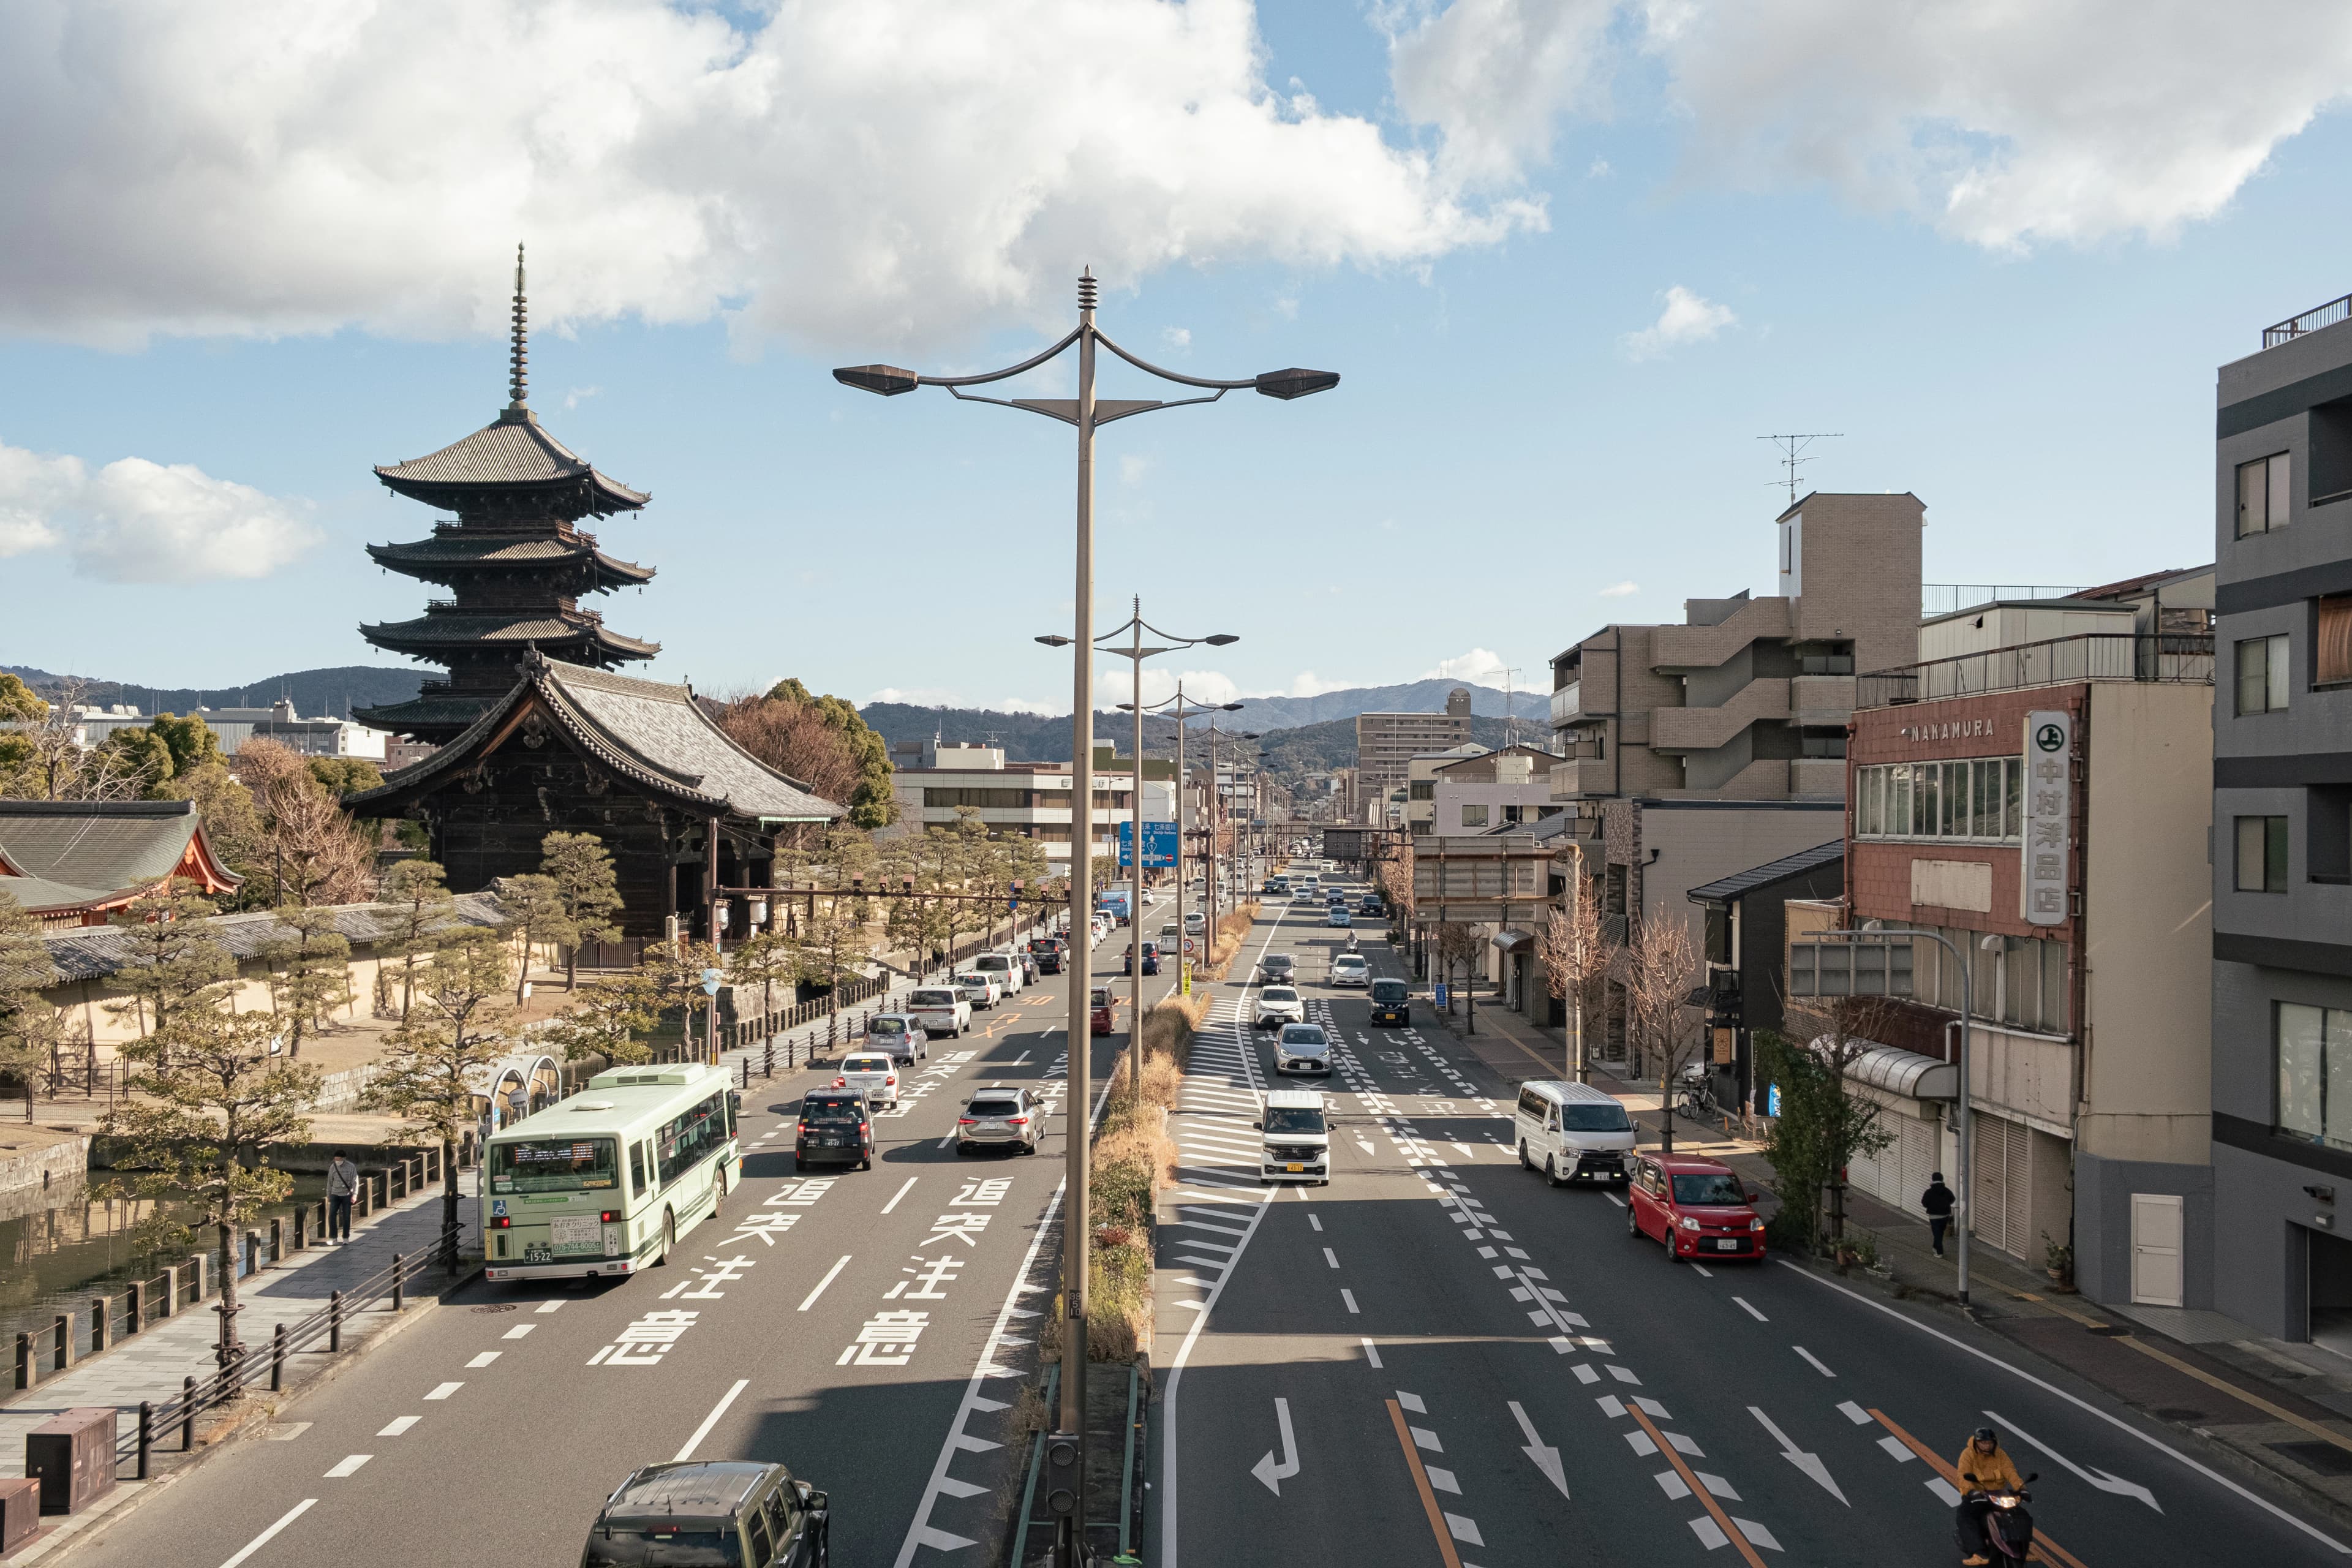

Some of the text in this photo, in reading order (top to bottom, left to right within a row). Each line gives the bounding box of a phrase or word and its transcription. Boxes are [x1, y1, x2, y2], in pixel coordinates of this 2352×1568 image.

[1911, 718, 1994, 743] NAKAMURA
[2034, 758, 2064, 913] 中村洋品店
[1014, 995, 1055, 1005] 50
[553, 1220, 599, 1229] あおきクリニック
[530, 1253, 551, 1262] 15-22
[586, 1176, 839, 1366] 追突注意
[836, 1176, 1014, 1366] 追突注意
